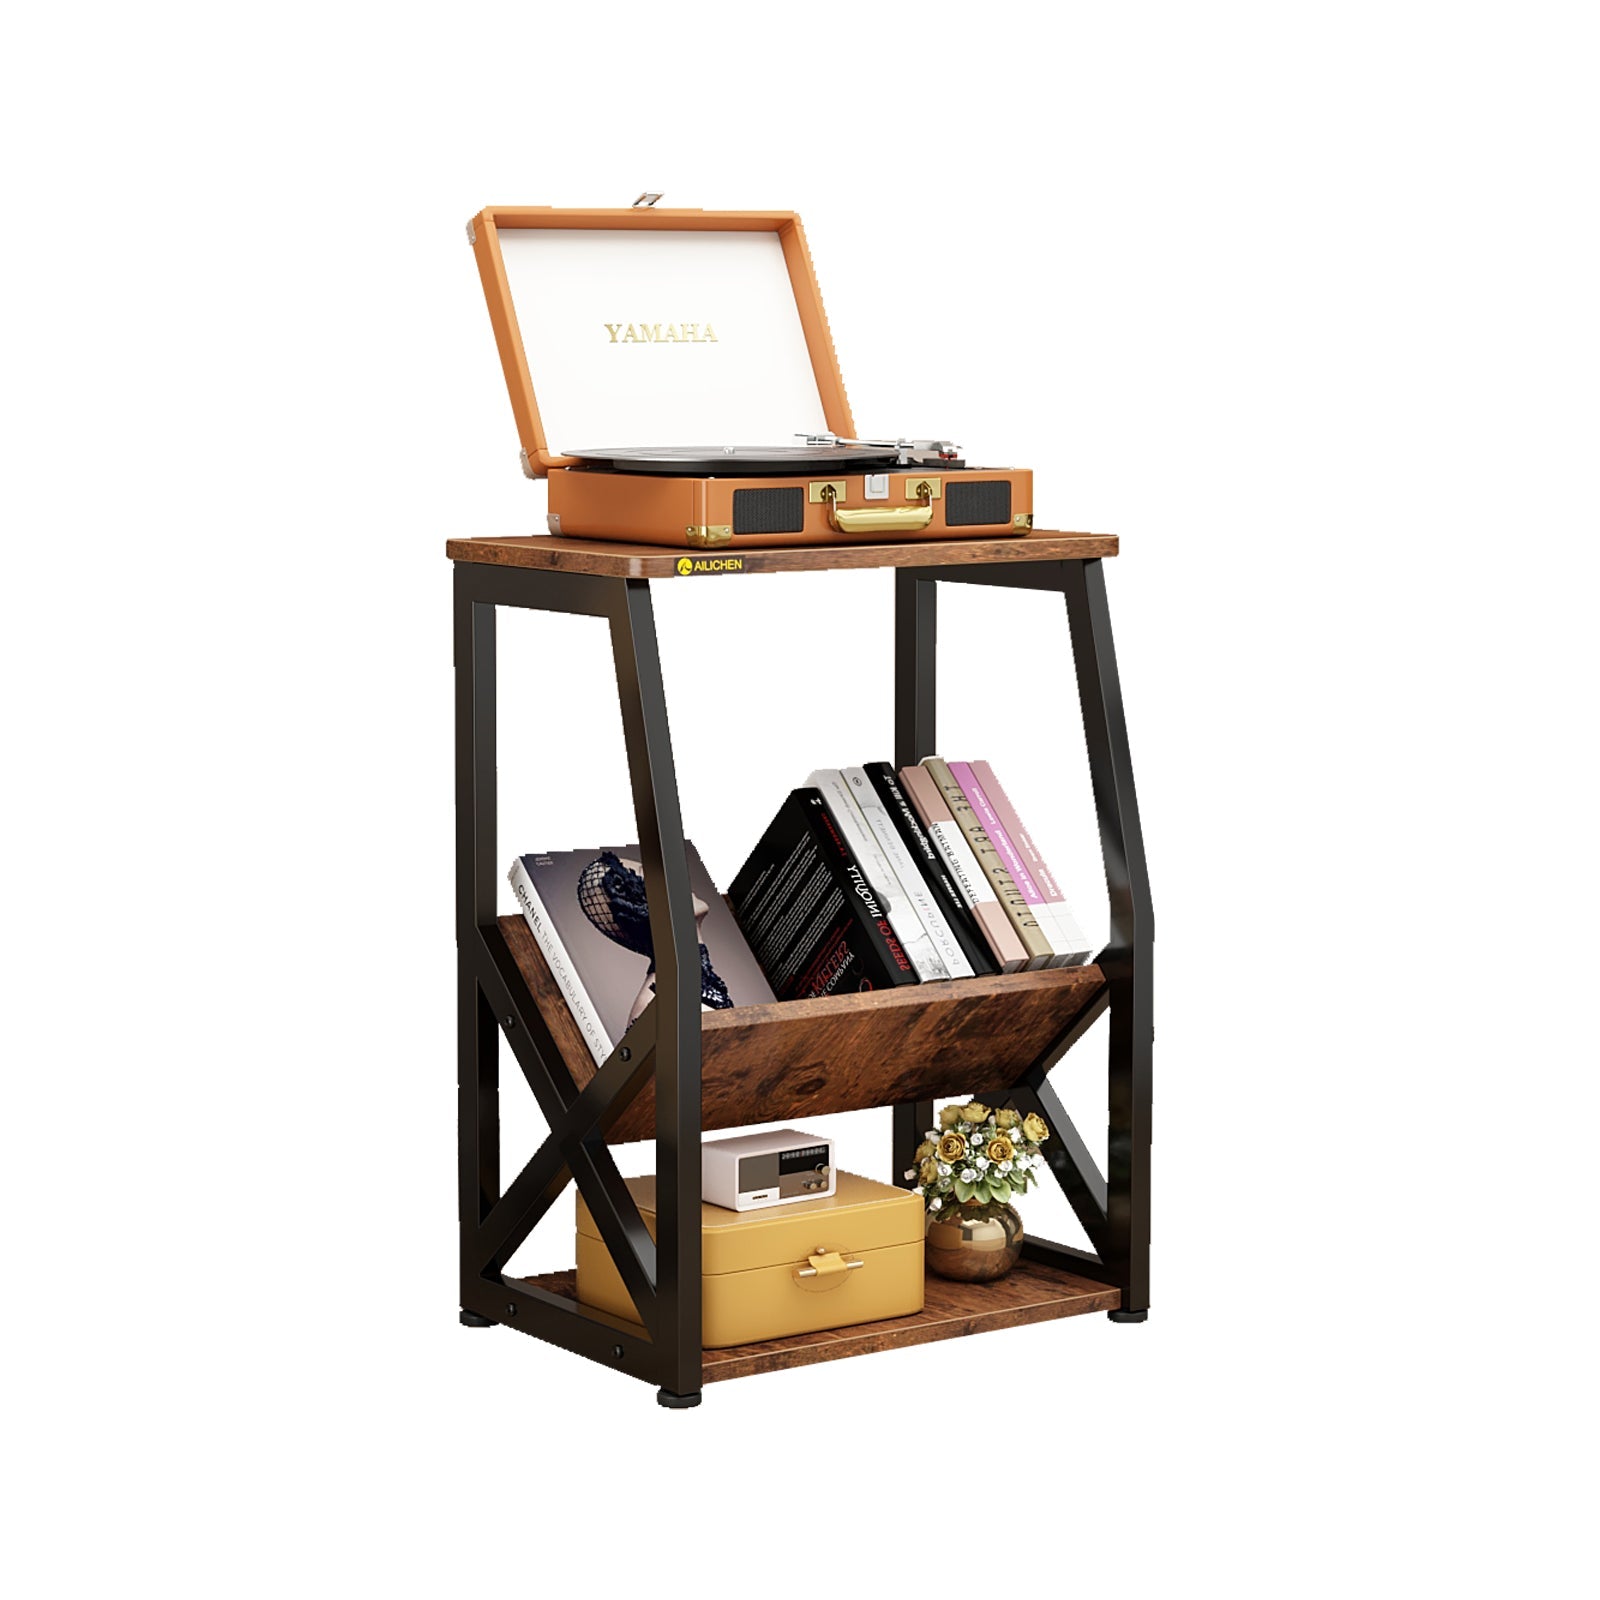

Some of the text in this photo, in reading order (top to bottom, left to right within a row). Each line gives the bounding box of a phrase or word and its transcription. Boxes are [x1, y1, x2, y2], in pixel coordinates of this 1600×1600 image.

[603, 323, 719, 343] YAMAHA
[694, 558, 742, 572] AILICHEN
[994, 830, 1022, 873] Wonderland
[953, 859, 979, 904] DEFEATING
[1024, 880, 1038, 899] Alice
[1038, 868, 1058, 897] Dracula
[518, 884, 607, 1060] CHANEL THE VOCABULARY OF STY
